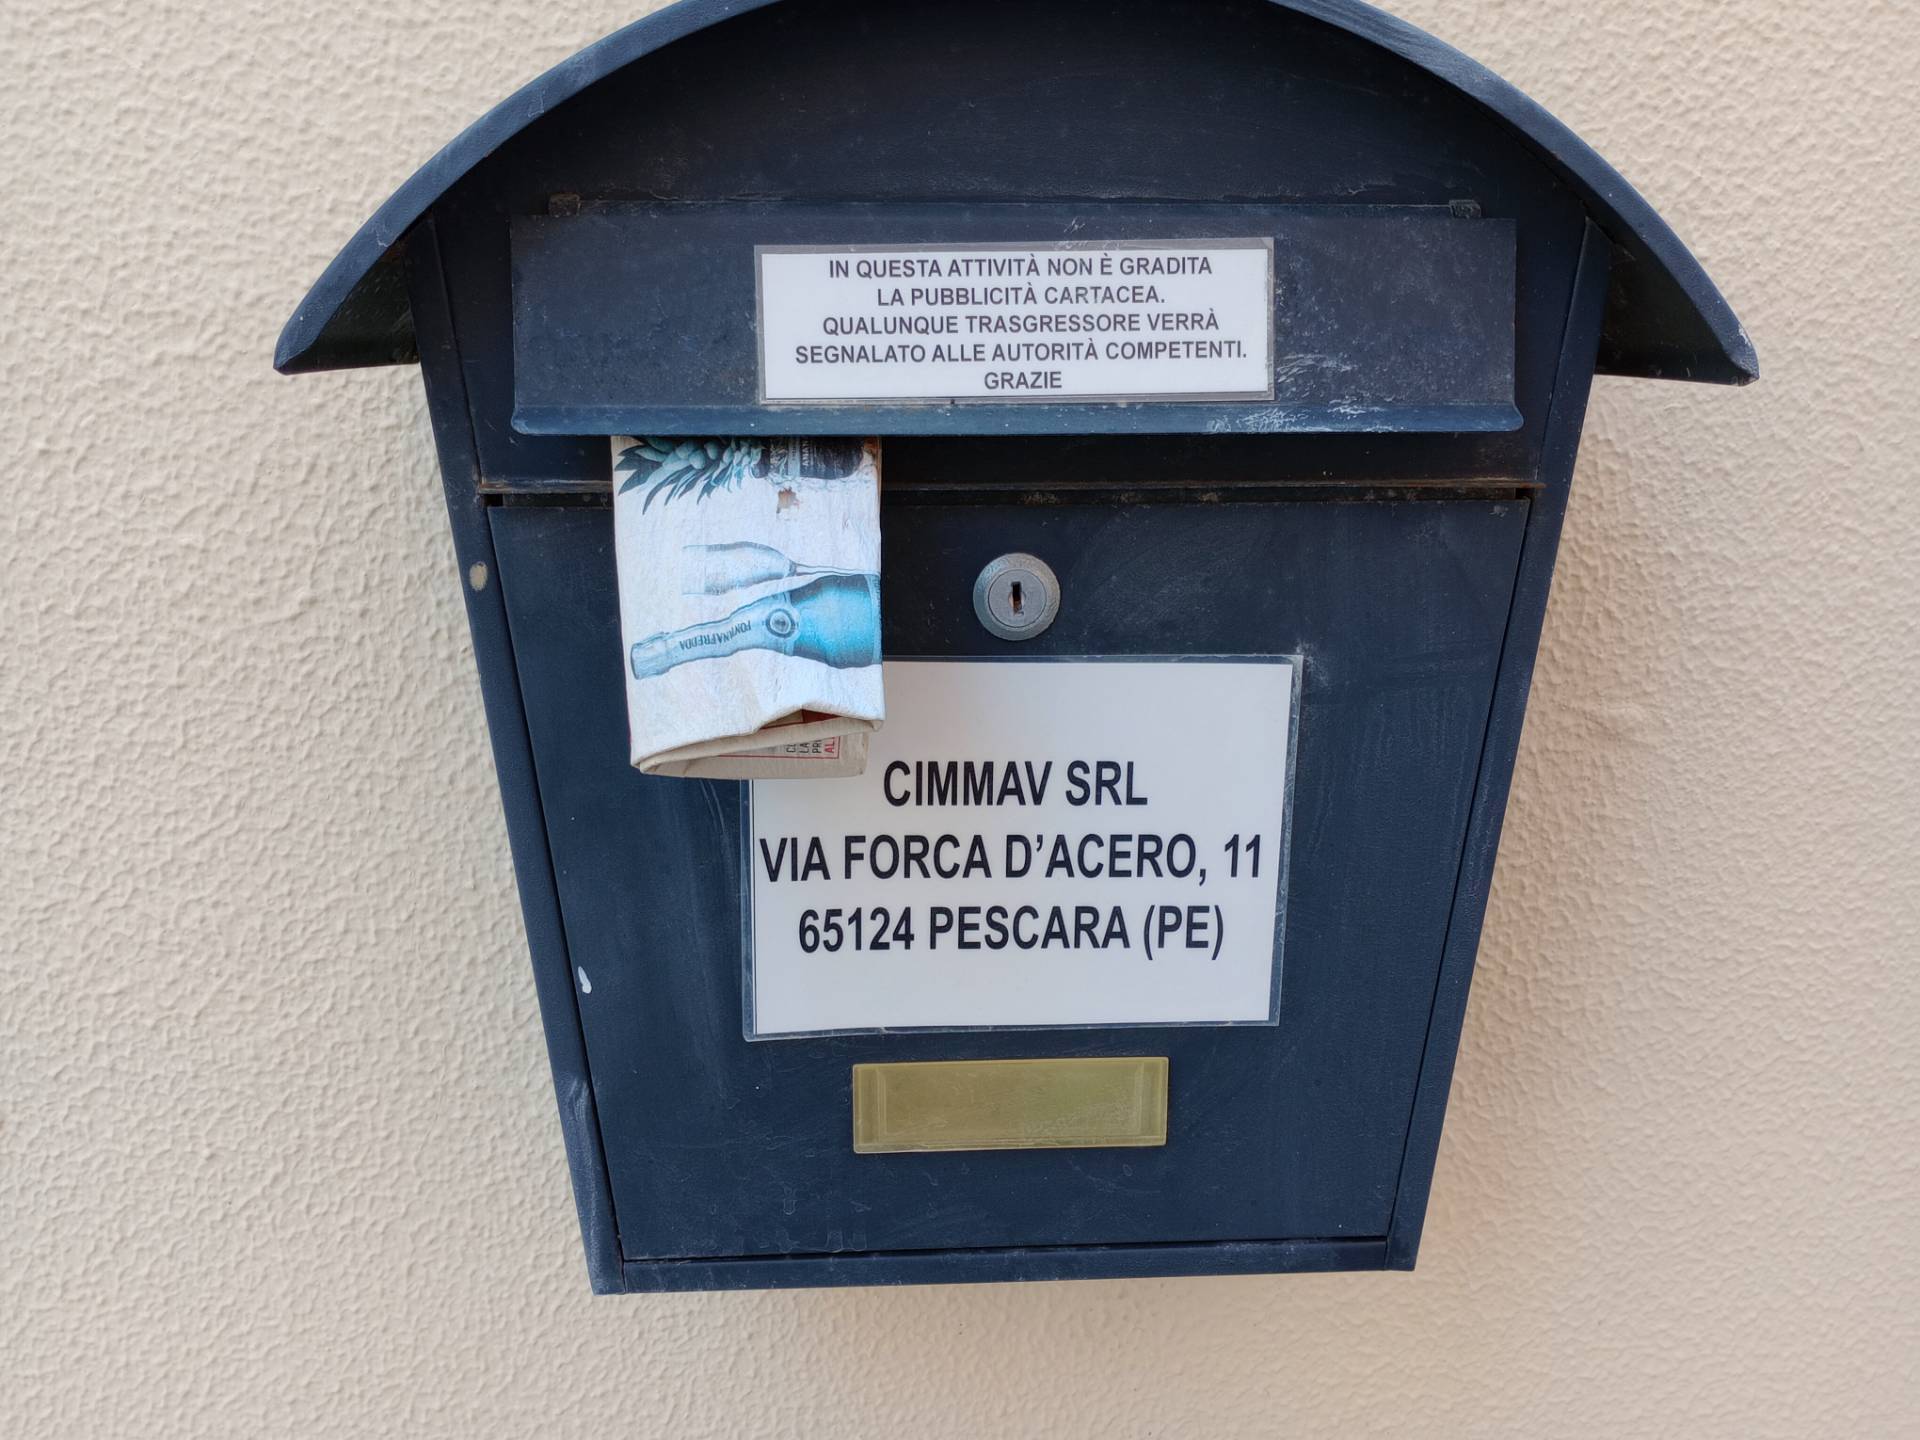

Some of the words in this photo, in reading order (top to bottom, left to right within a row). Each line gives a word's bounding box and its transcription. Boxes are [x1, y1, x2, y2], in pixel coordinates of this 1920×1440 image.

[829, 259, 849, 278] IN
[856, 259, 943, 279] QUESTA
[947, 253, 1041, 277] ATTIVITÀ
[1047, 257, 1093, 276] NON
[1100, 252, 1113, 276] È
[1119, 256, 1213, 276] GRADITA
[877, 288, 905, 307] LA
[911, 281, 1038, 306] PUBBLICITÀ
[1044, 285, 1165, 305] CARTACEA.
[822, 315, 959, 337] QUALUNQUE
[964, 313, 1141, 334] TRASGRESSORE
[1146, 307, 1220, 331] VERRÀ
[795, 344, 926, 364] SEGNALATO
[931, 343, 986, 363] ALLE
[991, 337, 1099, 362] AUTORITÀ
[1105, 340, 1247, 360] COMPETENTI.
[984, 371, 1063, 390] GRAZIE
[883, 760, 1053, 807] CIMMAV
[1065, 759, 1148, 807] SRL
[759, 836, 831, 883] VIA
[844, 833, 992, 880] FORCA
[1005, 833, 1207, 887] D’ACERO,
[1224, 833, 1261, 878] 11
[798, 906, 915, 954] 65124
[929, 905, 1131, 950] PESCARA
[1143, 904, 1224, 961] (PE)
